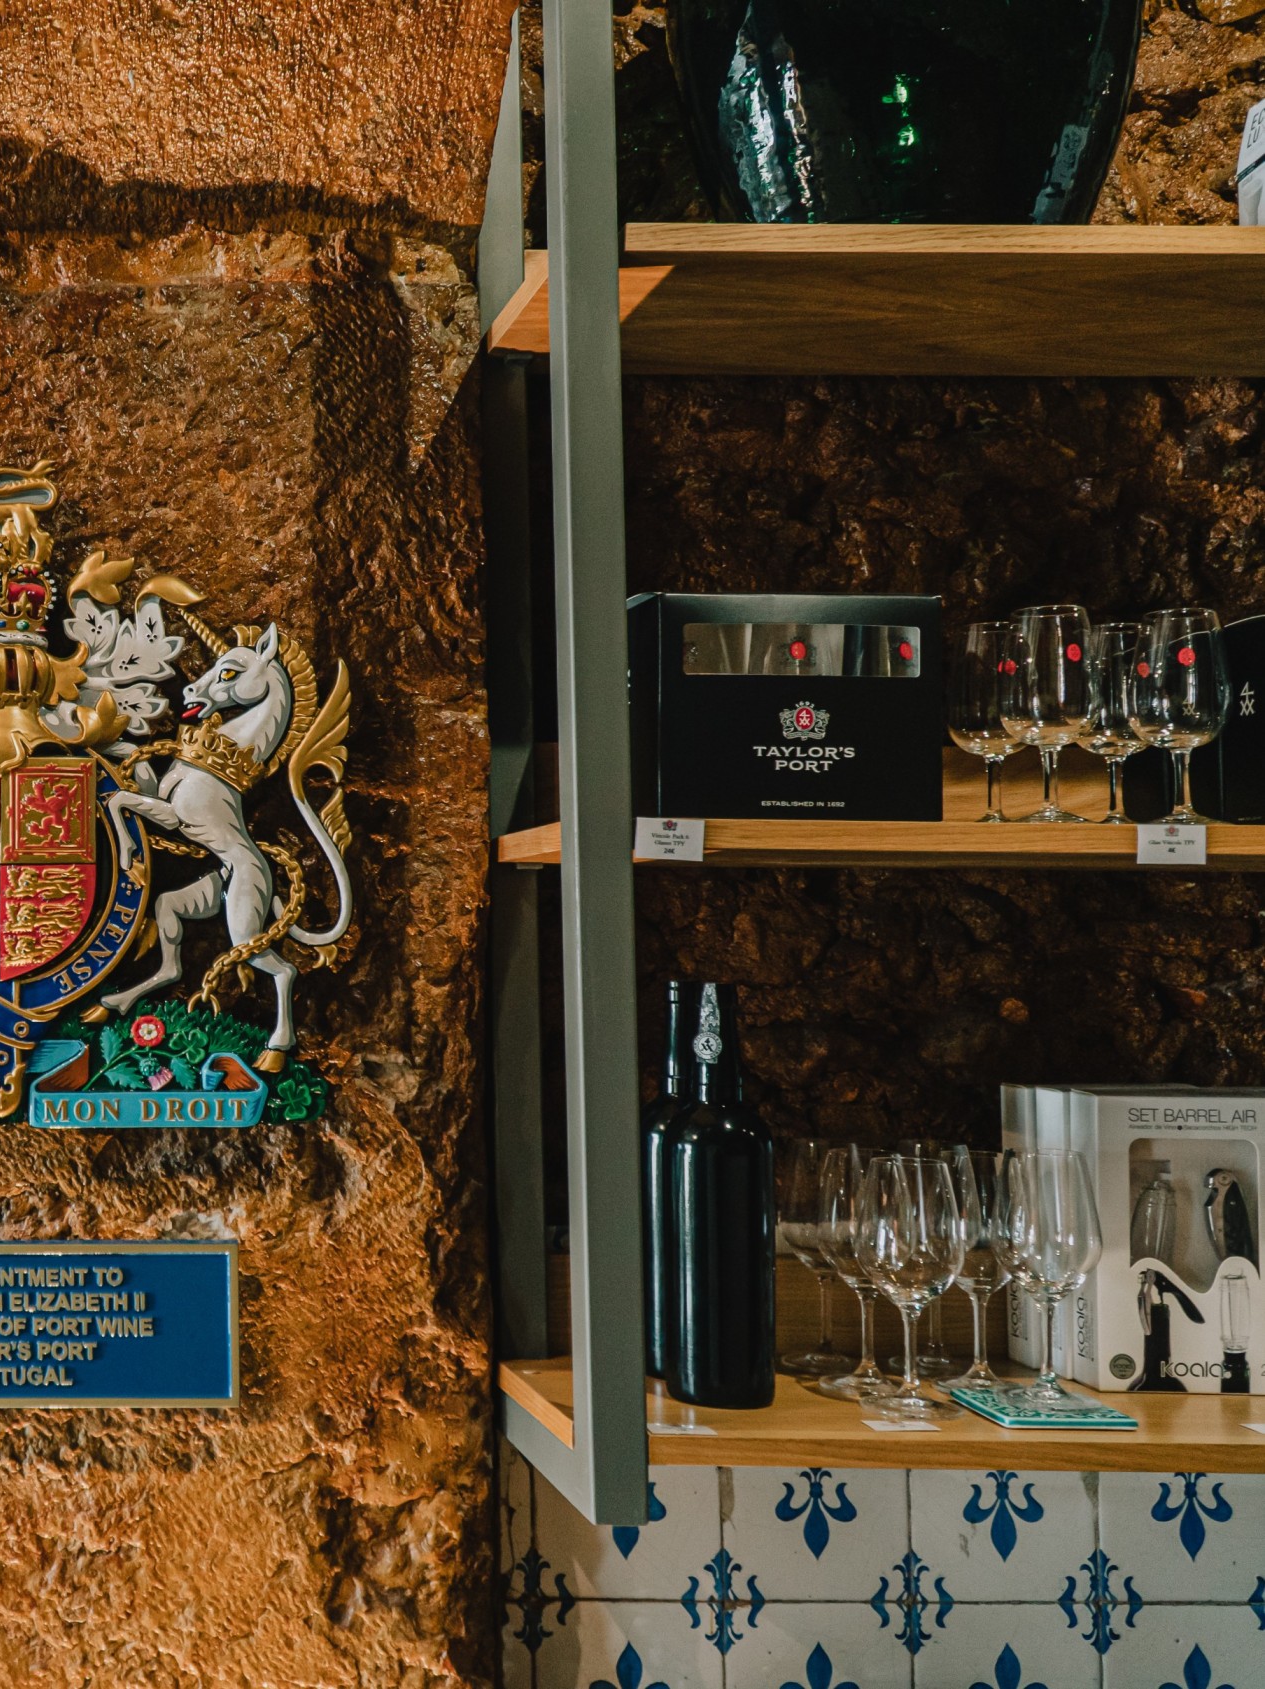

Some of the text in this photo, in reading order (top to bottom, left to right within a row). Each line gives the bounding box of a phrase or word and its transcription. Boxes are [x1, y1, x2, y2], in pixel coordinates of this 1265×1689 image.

[795, 701, 815, 709] 1692
[752, 746, 856, 760] TAYLOR'S
[774, 760, 834, 774] PORT
[52, 901, 136, 995] PENSE
[43, 1098, 249, 1123] MON DROIT
[1128, 1107, 1257, 1124] SET BARREL AIR
[93, 1267, 124, 1287] TO
[9, 1292, 128, 1312] ELIZABETH
[133, 1292, 146, 1312] II
[32, 1317, 94, 1337] PORT
[96, 1317, 154, 1338] WINE
[1075, 1297, 1088, 1358] koala
[36, 1341, 98, 1362] PORT
